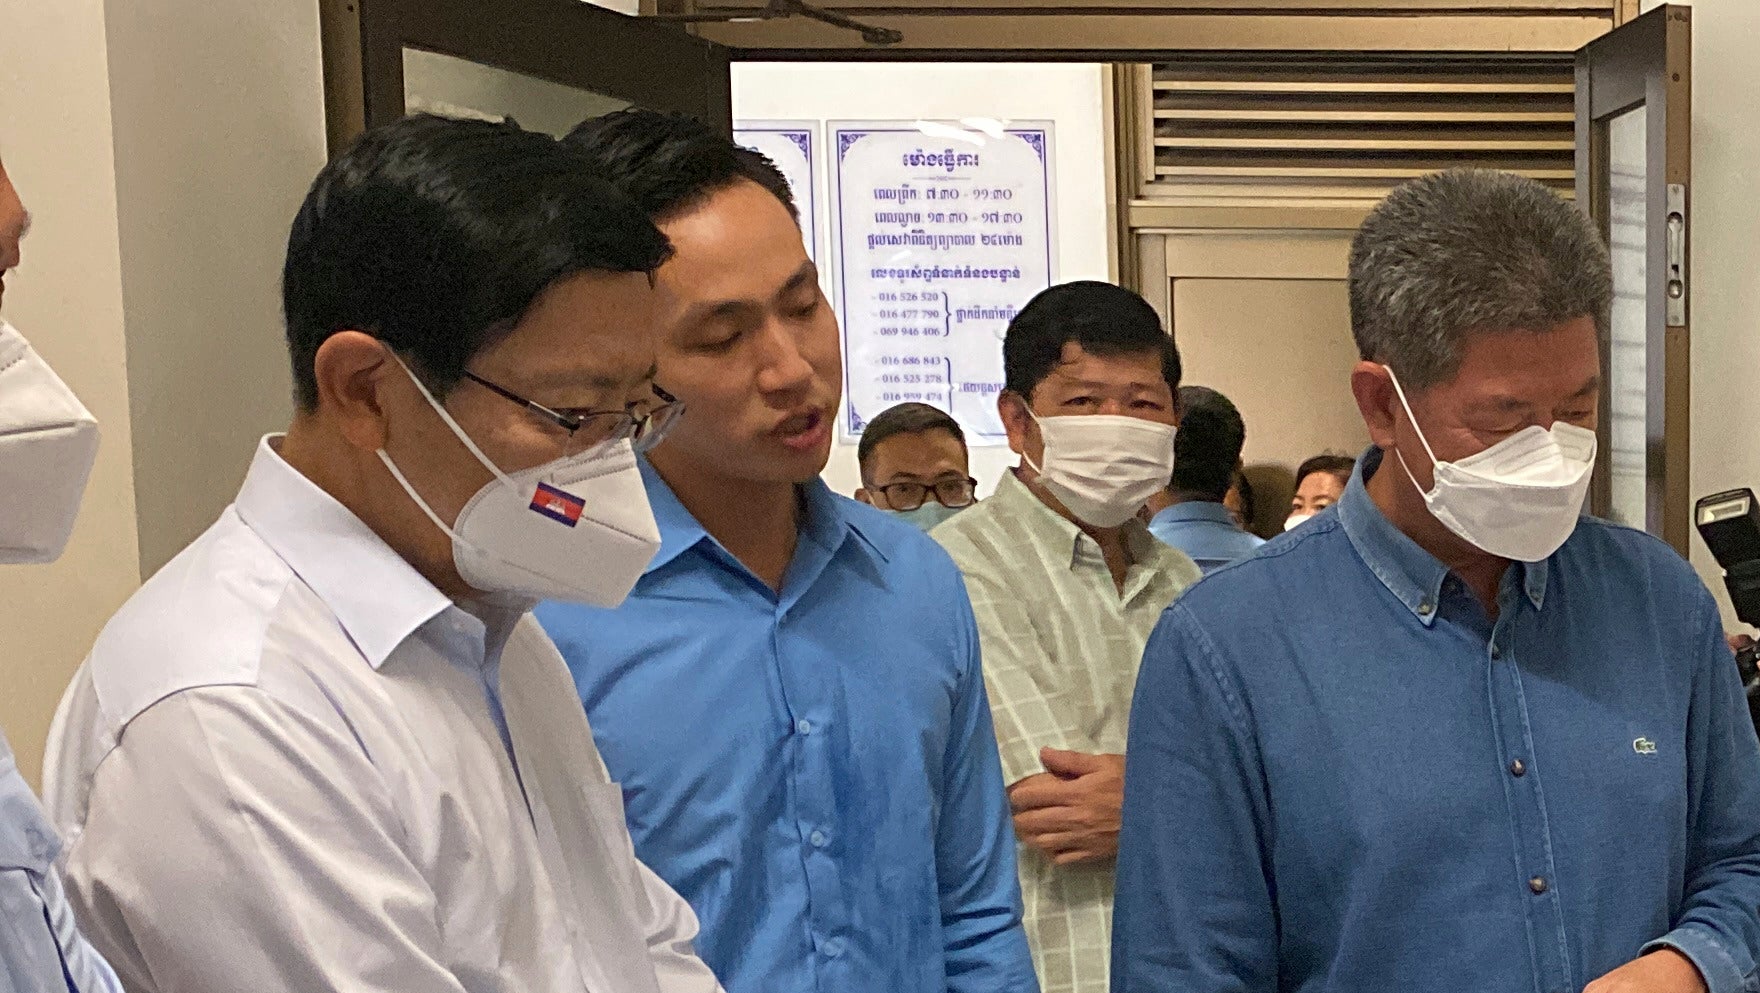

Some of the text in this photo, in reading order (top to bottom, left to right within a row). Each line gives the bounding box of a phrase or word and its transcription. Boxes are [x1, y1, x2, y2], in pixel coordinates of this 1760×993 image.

[879, 292, 939, 301] 016 526 520
[879, 310, 898, 319] 016
[901, 310, 918, 319] 477
[880, 327, 898, 336] 069
[881, 356, 900, 365] 016
[923, 356, 941, 365] 843
[882, 374, 900, 383] 016
[883, 392, 901, 401] 016
